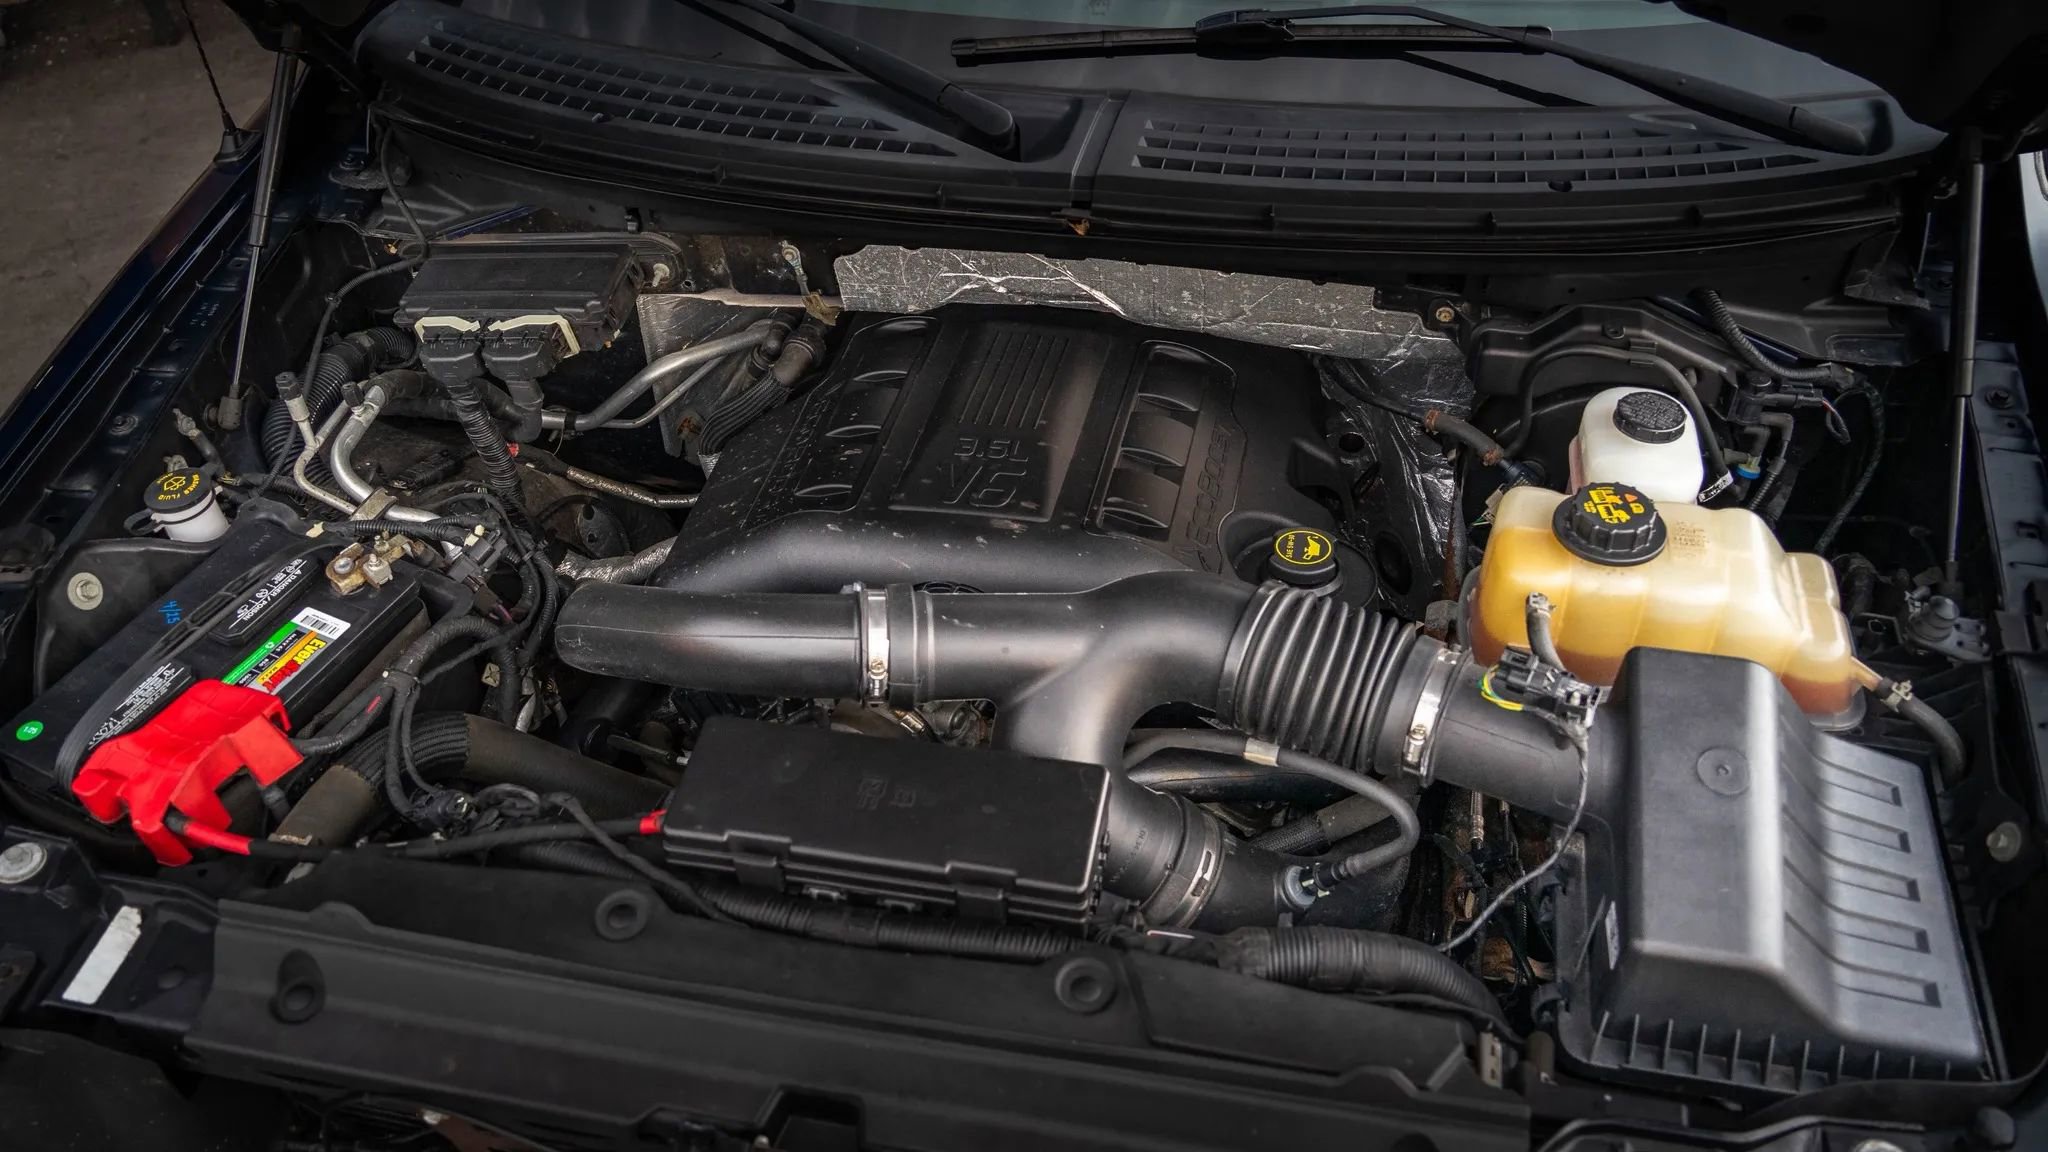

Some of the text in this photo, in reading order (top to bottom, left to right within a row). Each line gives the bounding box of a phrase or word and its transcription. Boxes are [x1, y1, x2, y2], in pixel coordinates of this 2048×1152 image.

[954, 437, 1029, 462] 3.5L
[943, 461, 1028, 508] V6
[157, 492, 181, 501] FLUID
[1286, 548, 1294, 558] SAE
[270, 574, 297, 597] DANGER
[242, 600, 268, 621] POISON
